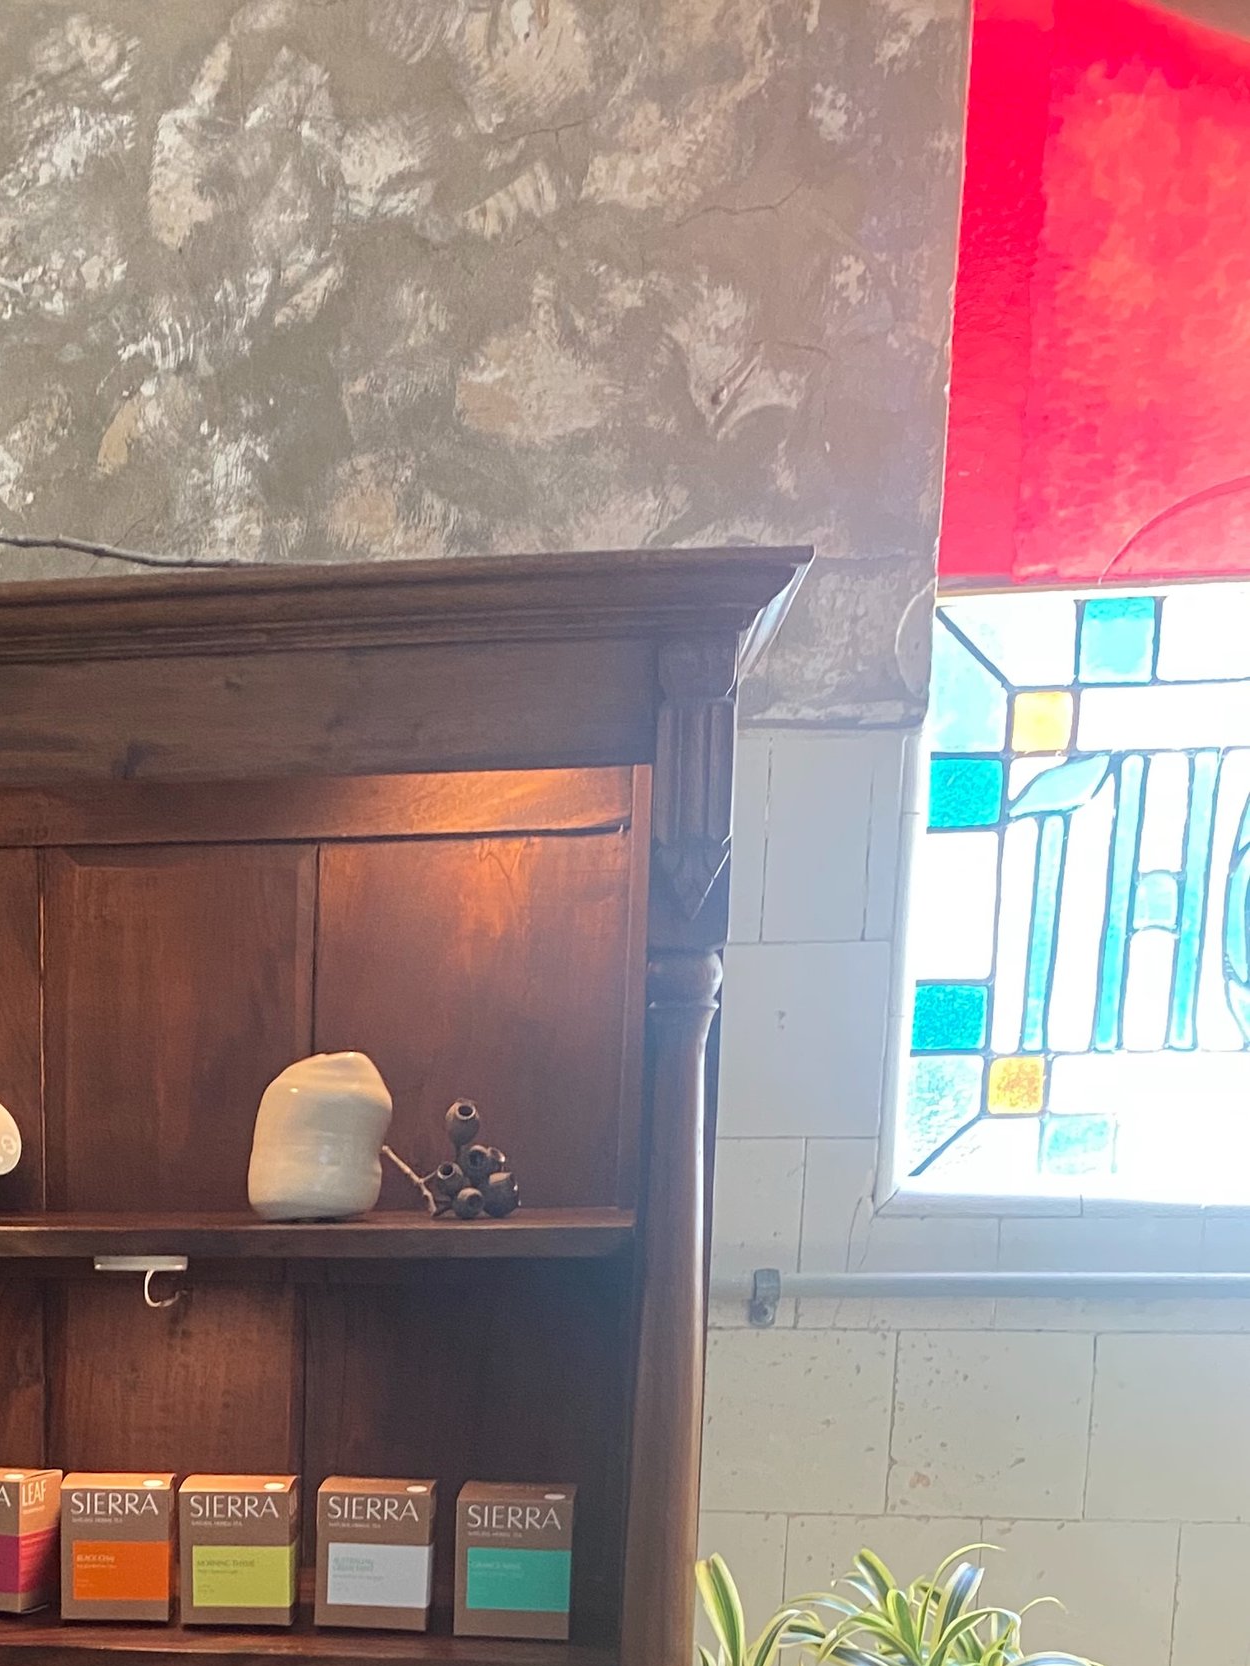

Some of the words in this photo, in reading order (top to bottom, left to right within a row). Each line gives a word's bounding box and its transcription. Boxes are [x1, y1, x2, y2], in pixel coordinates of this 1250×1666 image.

[21, 1479, 47, 1507] LEAF
[70, 1491, 159, 1516] SIERRA
[190, 1495, 279, 1519] SIERRA
[327, 1495, 419, 1522] SIERRA
[467, 1504, 562, 1531] SIERRA
